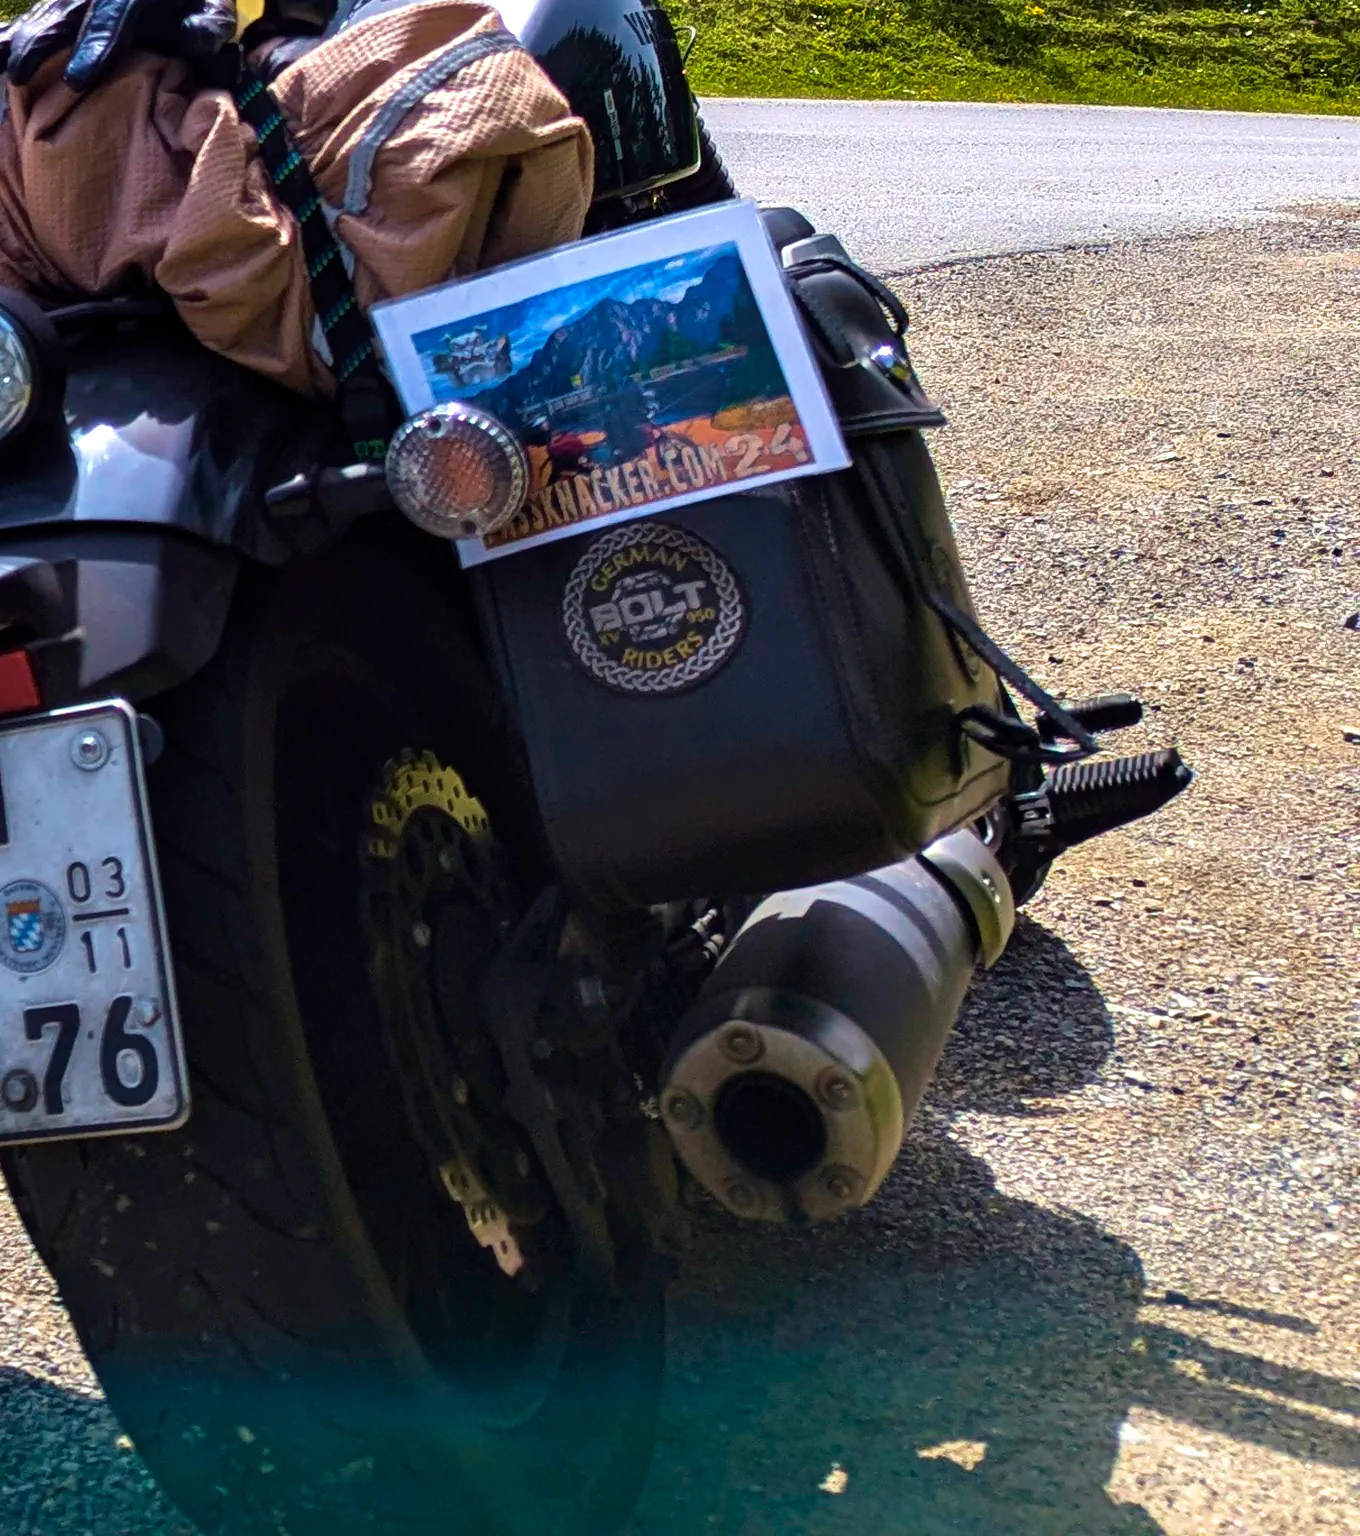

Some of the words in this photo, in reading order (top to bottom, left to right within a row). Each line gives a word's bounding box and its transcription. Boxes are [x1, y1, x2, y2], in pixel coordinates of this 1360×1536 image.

[487, 443, 727, 545] SSKNACKER.COM
[724, 423, 808, 478] 24
[591, 545, 688, 591] GERMAN
[589, 580, 706, 634] BOLT
[621, 631, 703, 668] RIDERS
[66, 856, 126, 903] 03
[81, 926, 133, 973] 11
[23, 995, 160, 1115] 76
